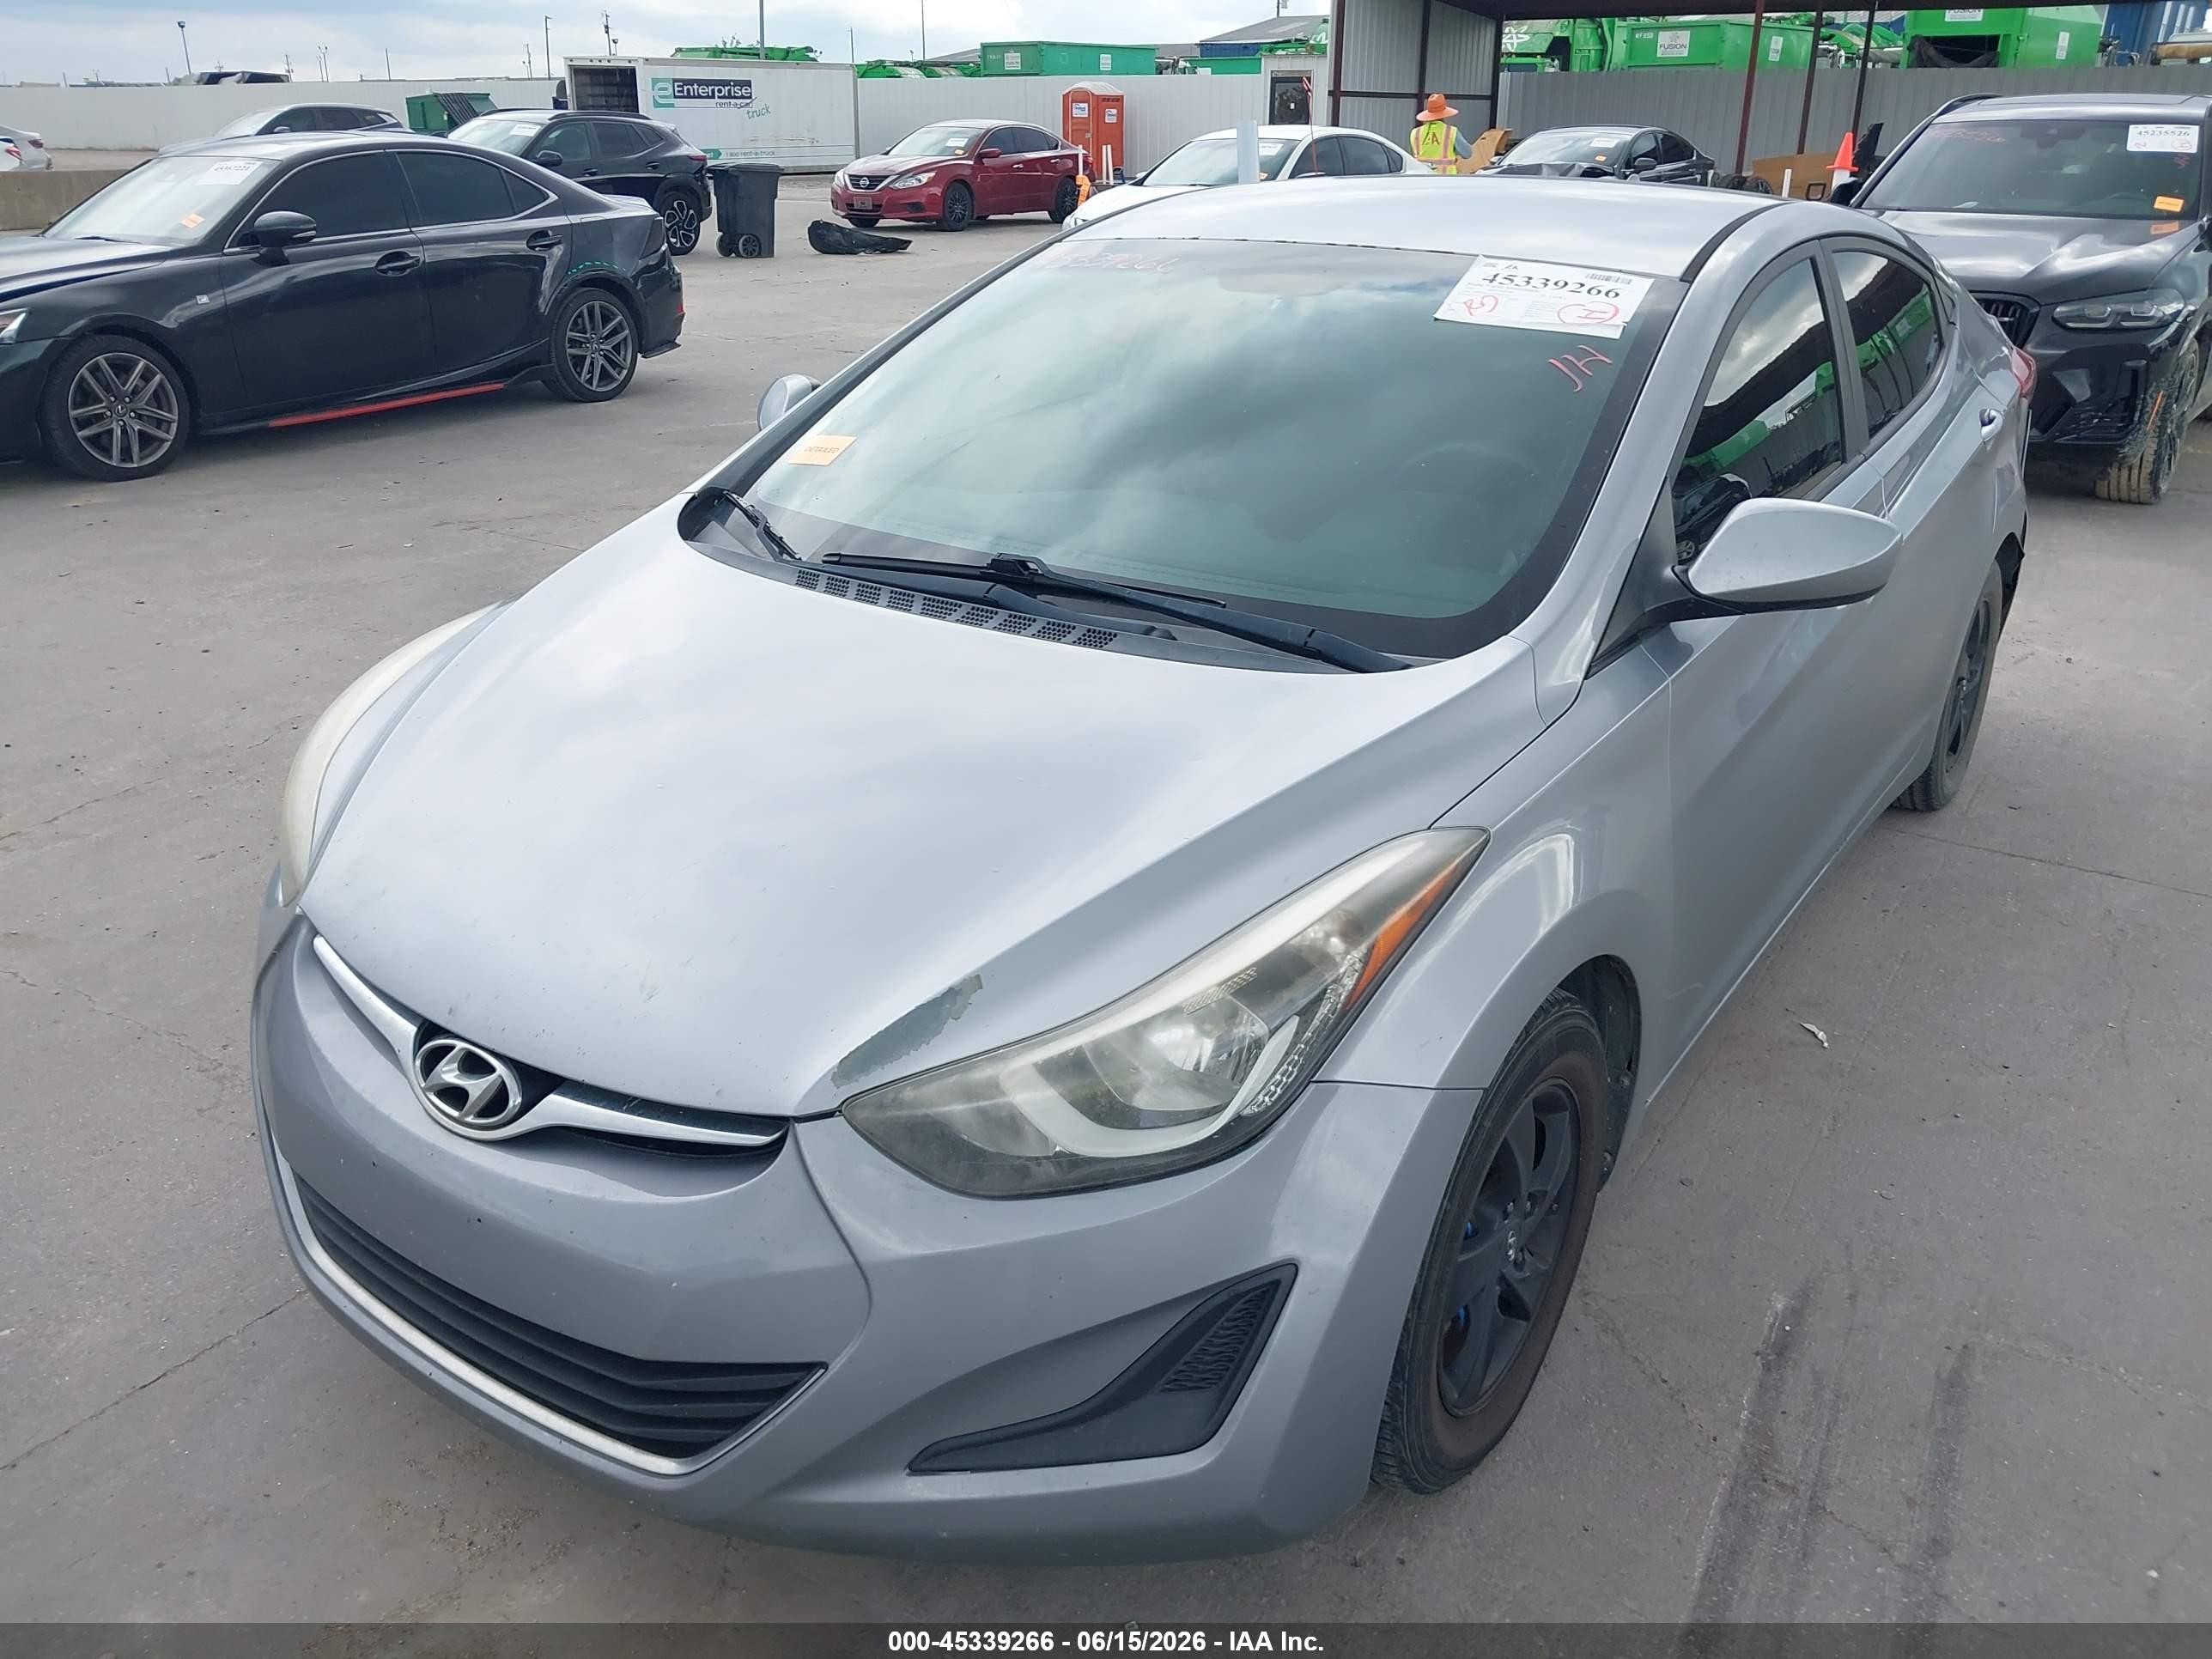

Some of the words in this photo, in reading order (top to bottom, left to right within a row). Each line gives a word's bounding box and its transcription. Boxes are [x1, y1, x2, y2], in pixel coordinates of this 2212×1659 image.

[674, 82, 751, 98] Enterprise
[746, 104, 771, 119] truck
[1482, 272, 1623, 299] 45339266
